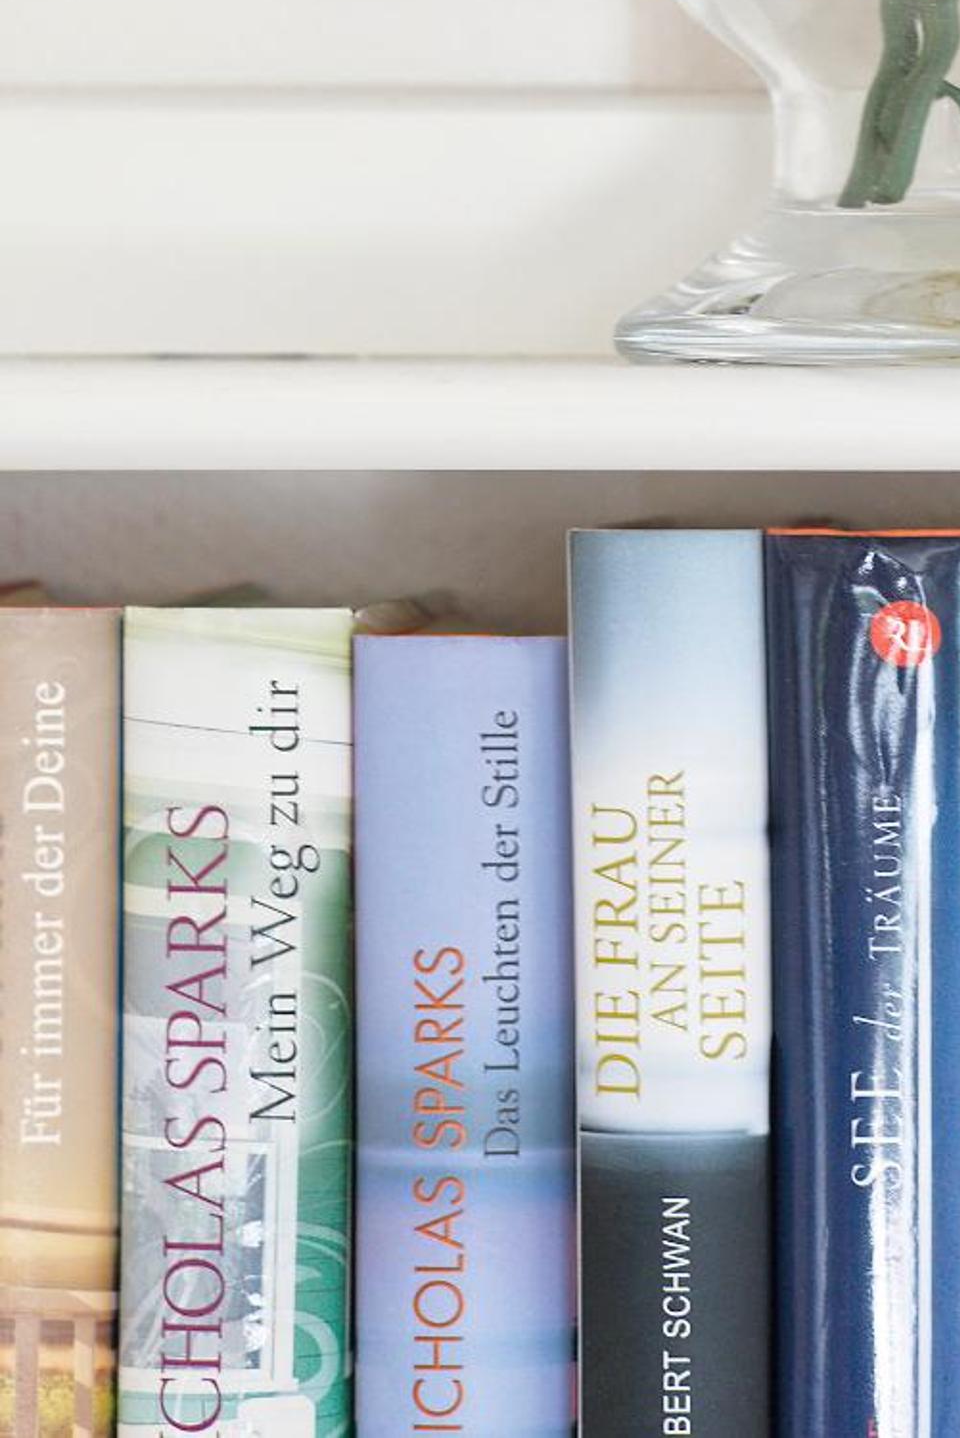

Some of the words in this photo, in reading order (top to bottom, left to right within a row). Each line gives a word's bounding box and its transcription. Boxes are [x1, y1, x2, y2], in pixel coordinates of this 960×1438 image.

[22, 680, 66, 813] Deine
[249, 680, 301, 753] dir
[480, 710, 520, 810] Stille
[21, 825, 66, 897] der
[268, 770, 300, 826] zu
[480, 824, 520, 883] der
[647, 769, 688, 944] SEINER
[250, 844, 321, 967] Weg
[591, 802, 640, 970] FRAU
[865, 793, 902, 963] TRÄUME
[20, 912, 64, 1055] immer
[164, 804, 231, 1094] SPARKS
[481, 899, 521, 1074] Leuchten
[649, 962, 689, 1032] AN
[697, 879, 748, 1060] SEITE
[852, 981, 903, 1043] der
[19, 1073, 63, 1146] Für
[249, 992, 297, 1124] Mein
[413, 946, 466, 1149] SPARKS
[594, 989, 642, 1104] DIE
[483, 1088, 521, 1159] Das
[850, 1069, 903, 1188] SEE
[159, 1115, 227, 1438] CHOLAS
[412, 1175, 465, 1432] ICHOLAS
[661, 1195, 692, 1339] SCHWAN
[661, 1350, 692, 1436] BERT
